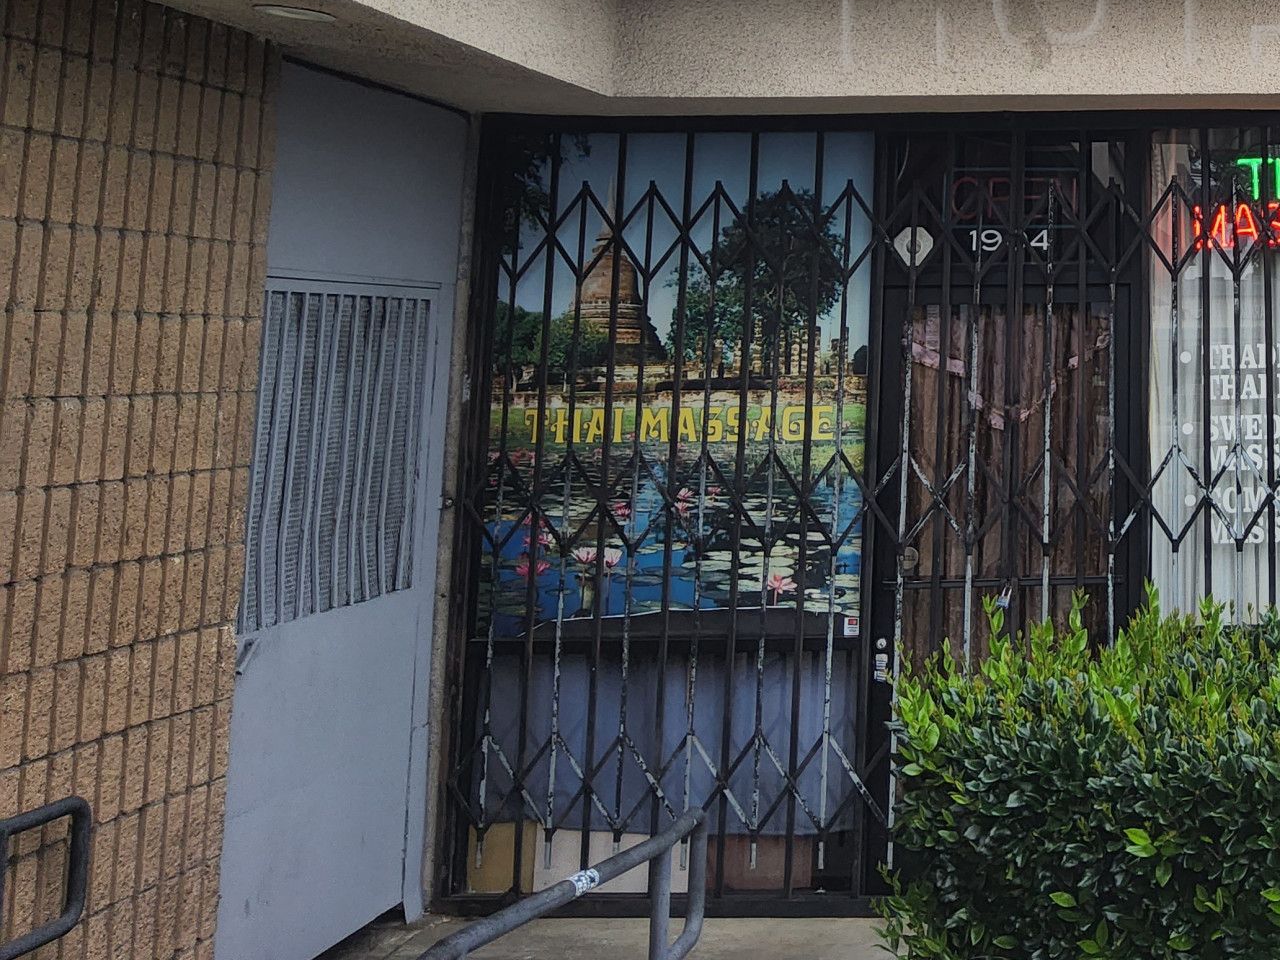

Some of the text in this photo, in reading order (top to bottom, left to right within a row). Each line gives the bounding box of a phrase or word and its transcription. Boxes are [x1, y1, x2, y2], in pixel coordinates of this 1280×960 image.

[968, 230, 1049, 252] 194
[524, 404, 834, 444] THAI MASSAGE
